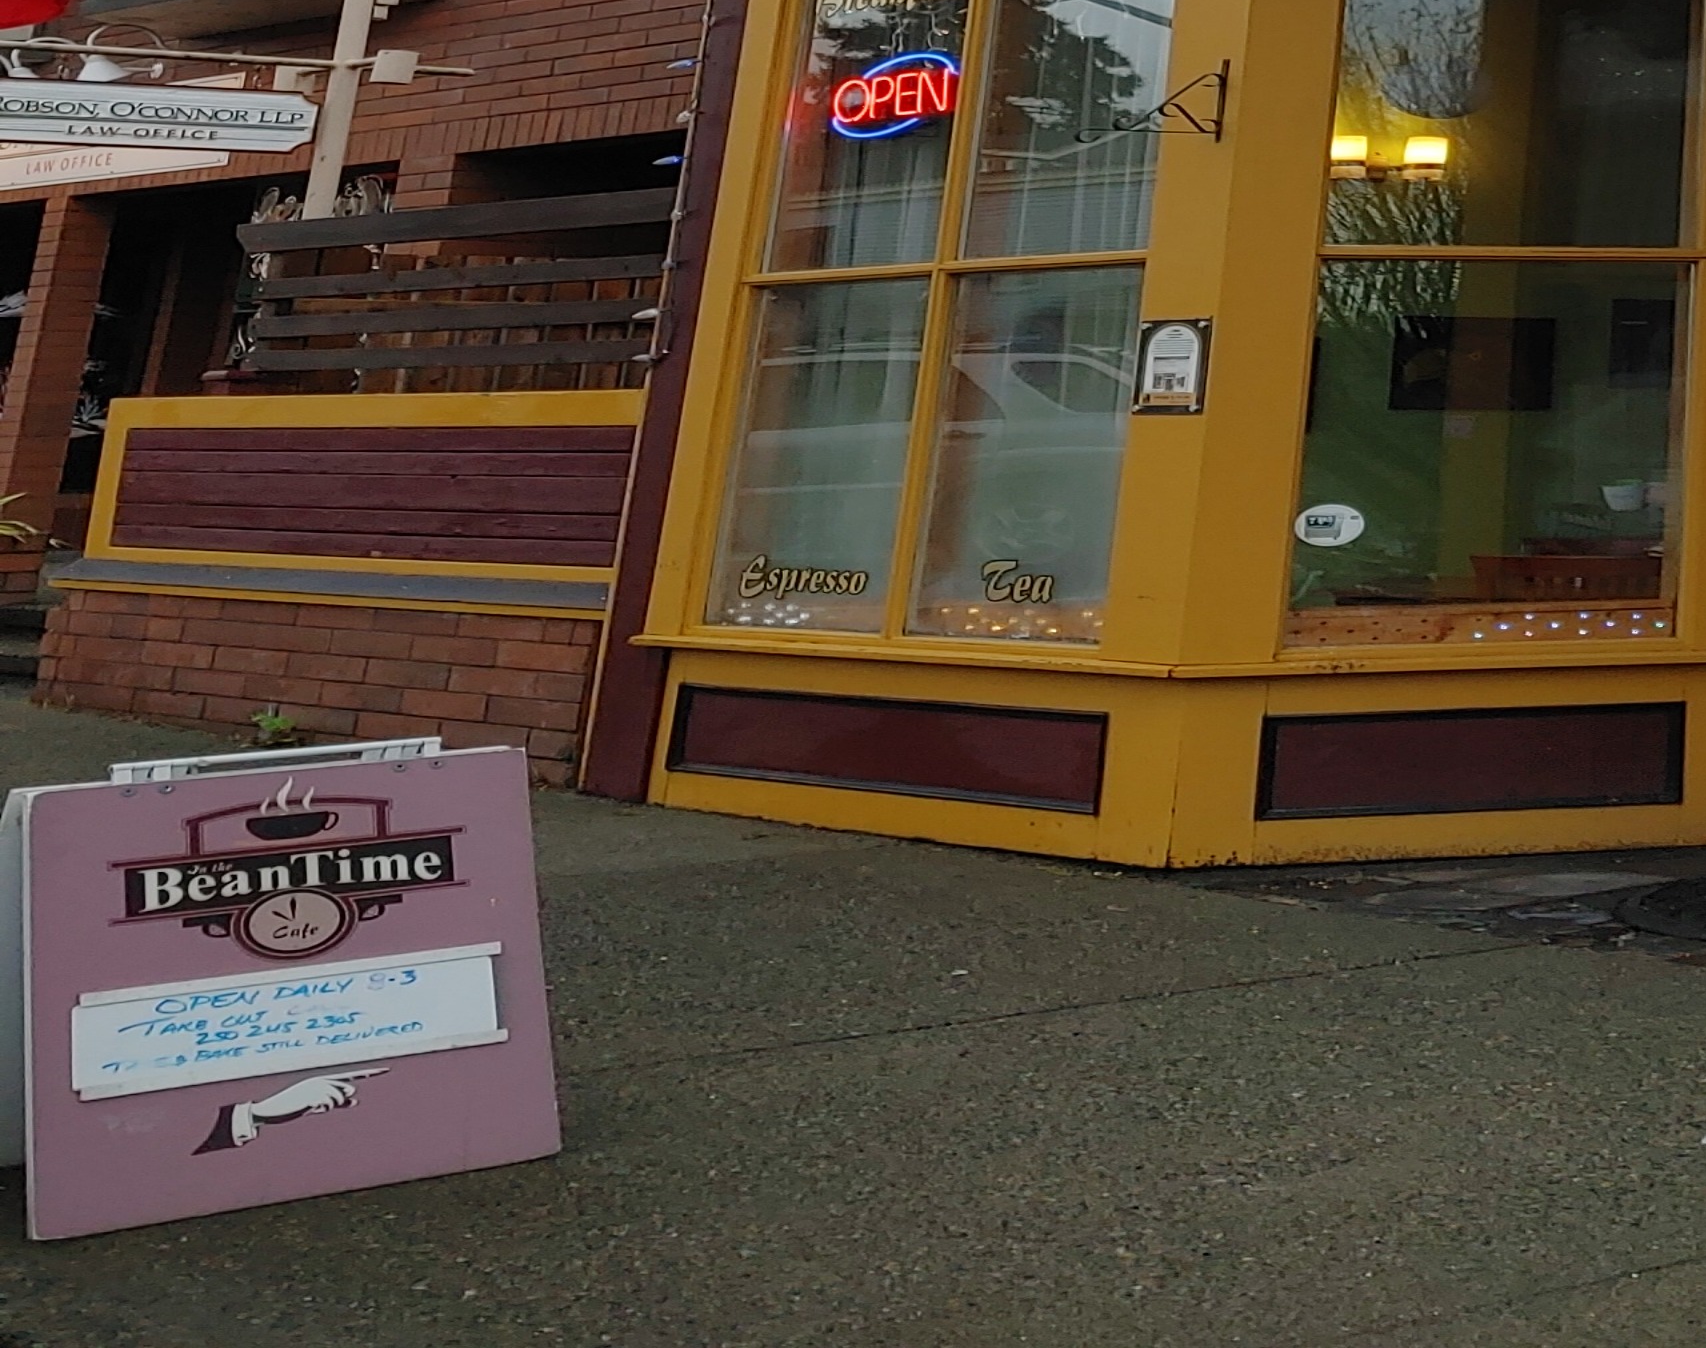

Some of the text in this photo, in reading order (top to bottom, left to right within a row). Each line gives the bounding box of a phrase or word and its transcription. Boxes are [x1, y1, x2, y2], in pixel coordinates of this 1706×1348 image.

[0, 96, 100, 118] OBSON,
[258, 111, 304, 124] LLP
[832, 68, 949, 124] OPEN
[65, 125, 220, 141] LAW OFFICE
[26, 153, 113, 176] LAW OFFICE
[739, 554, 868, 599] Espresso
[981, 560, 1053, 602] Tea
[137, 848, 443, 914] BeanTime
[272, 923, 319, 940] Cafe
[155, 989, 260, 1014] OPEN
[272, 977, 353, 1001] DAILY
[118, 1015, 208, 1037] TAKE
[221, 1010, 269, 1029] OUT
[315, 1020, 423, 1046] DELIVERED
